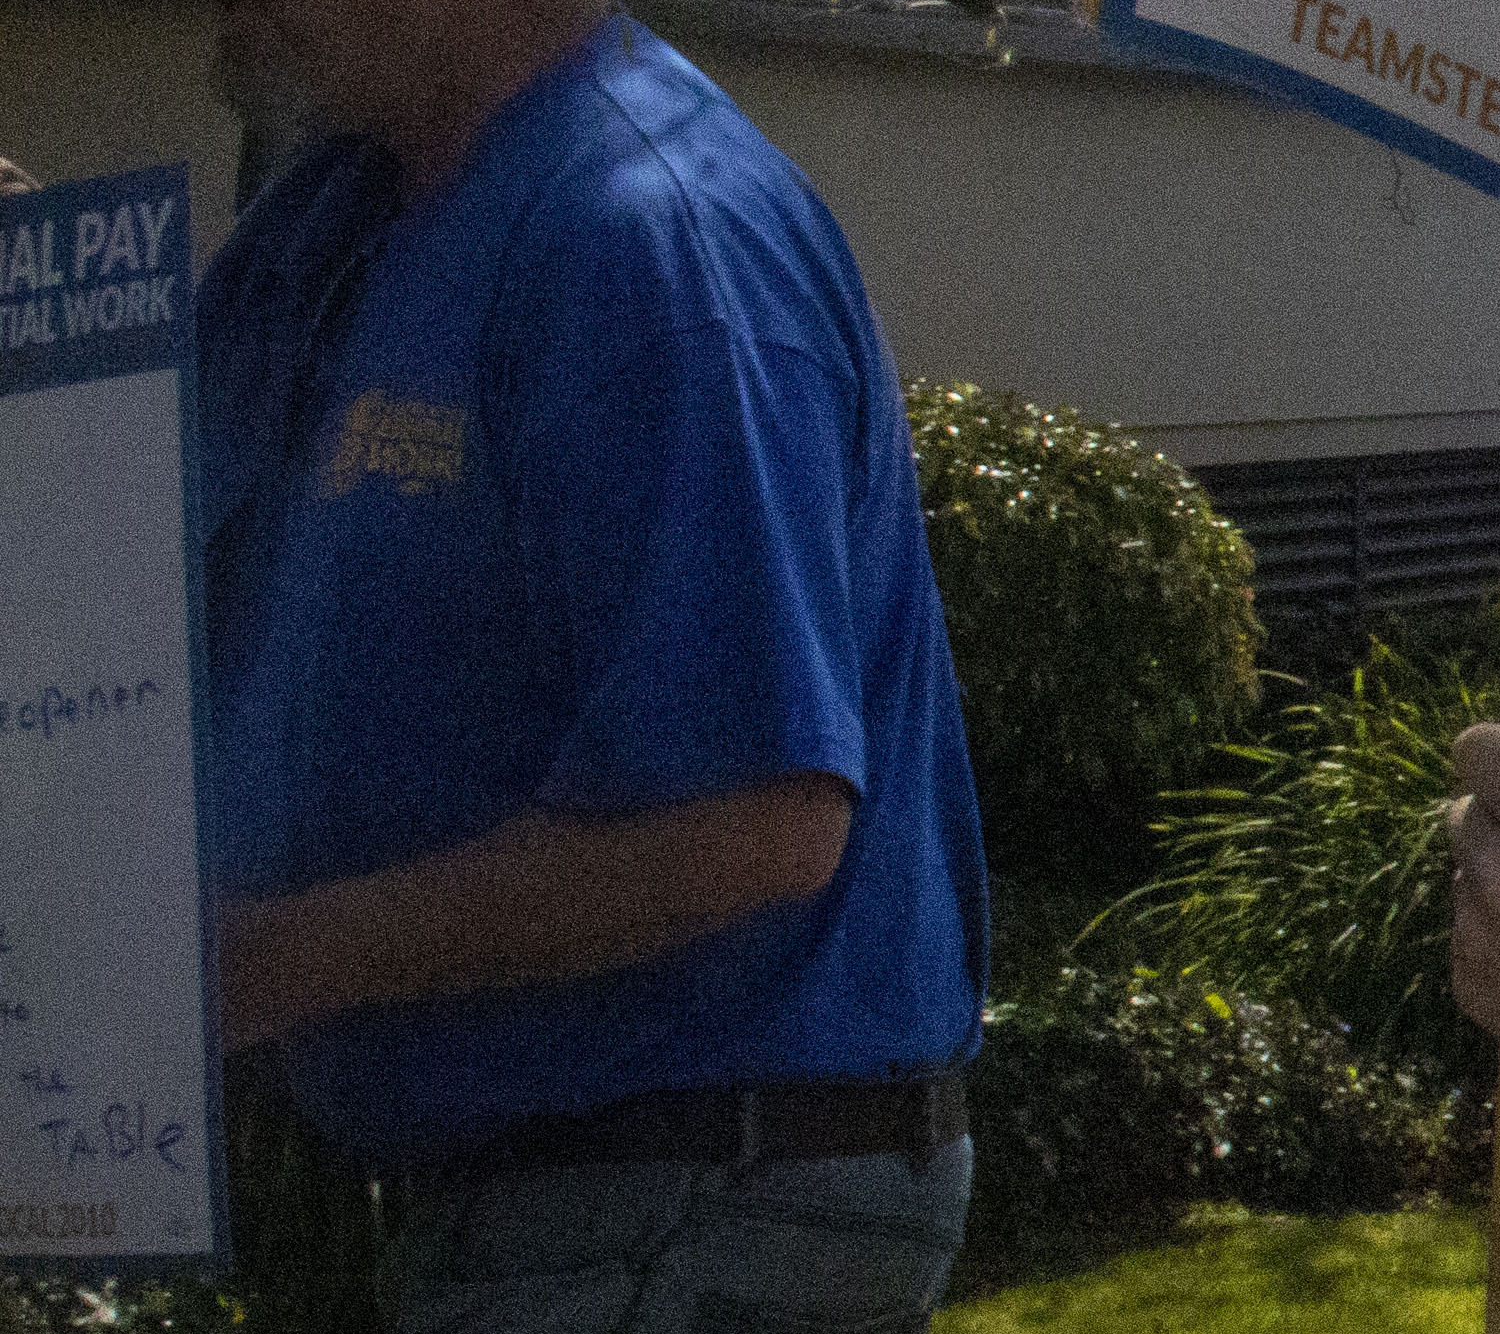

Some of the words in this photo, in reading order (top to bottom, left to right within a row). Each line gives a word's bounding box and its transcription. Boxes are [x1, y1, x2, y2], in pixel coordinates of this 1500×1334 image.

[73, 198, 175, 281] PAY
[62, 272, 175, 340] WORK
[57, 1202, 117, 1239] 2010
